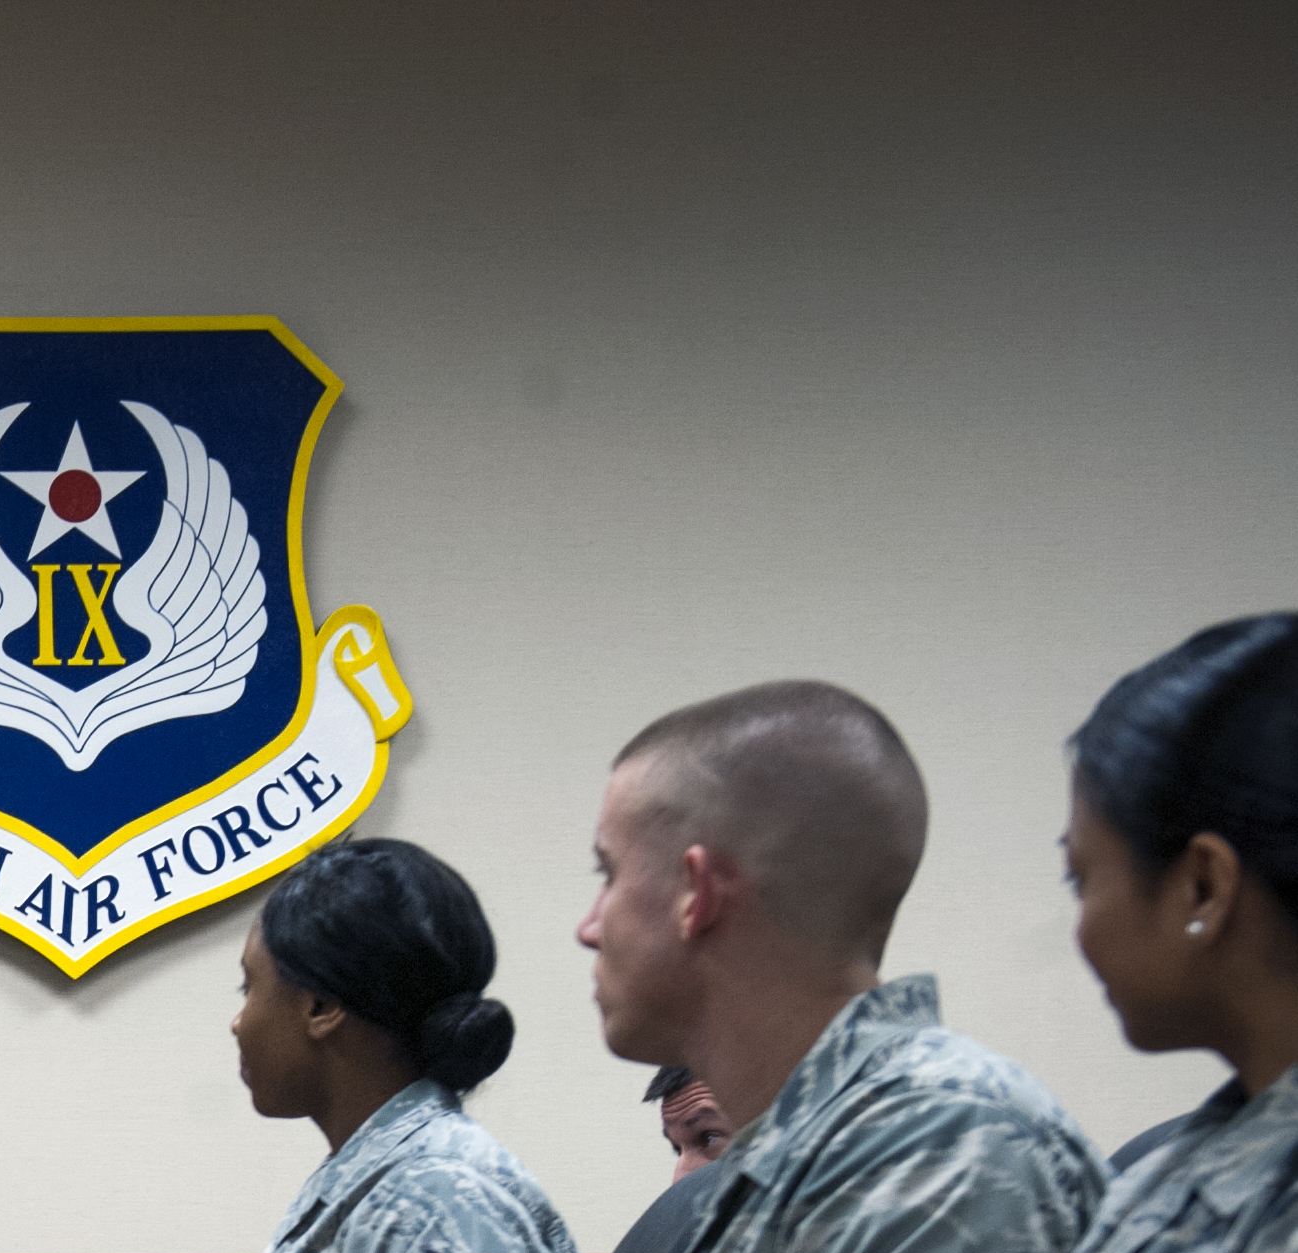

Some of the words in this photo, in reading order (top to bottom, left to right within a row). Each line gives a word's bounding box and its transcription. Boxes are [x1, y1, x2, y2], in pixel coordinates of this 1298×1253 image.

[32, 565, 125, 666] IX
[14, 873, 126, 947] AIR
[137, 752, 343, 902] FORCE
